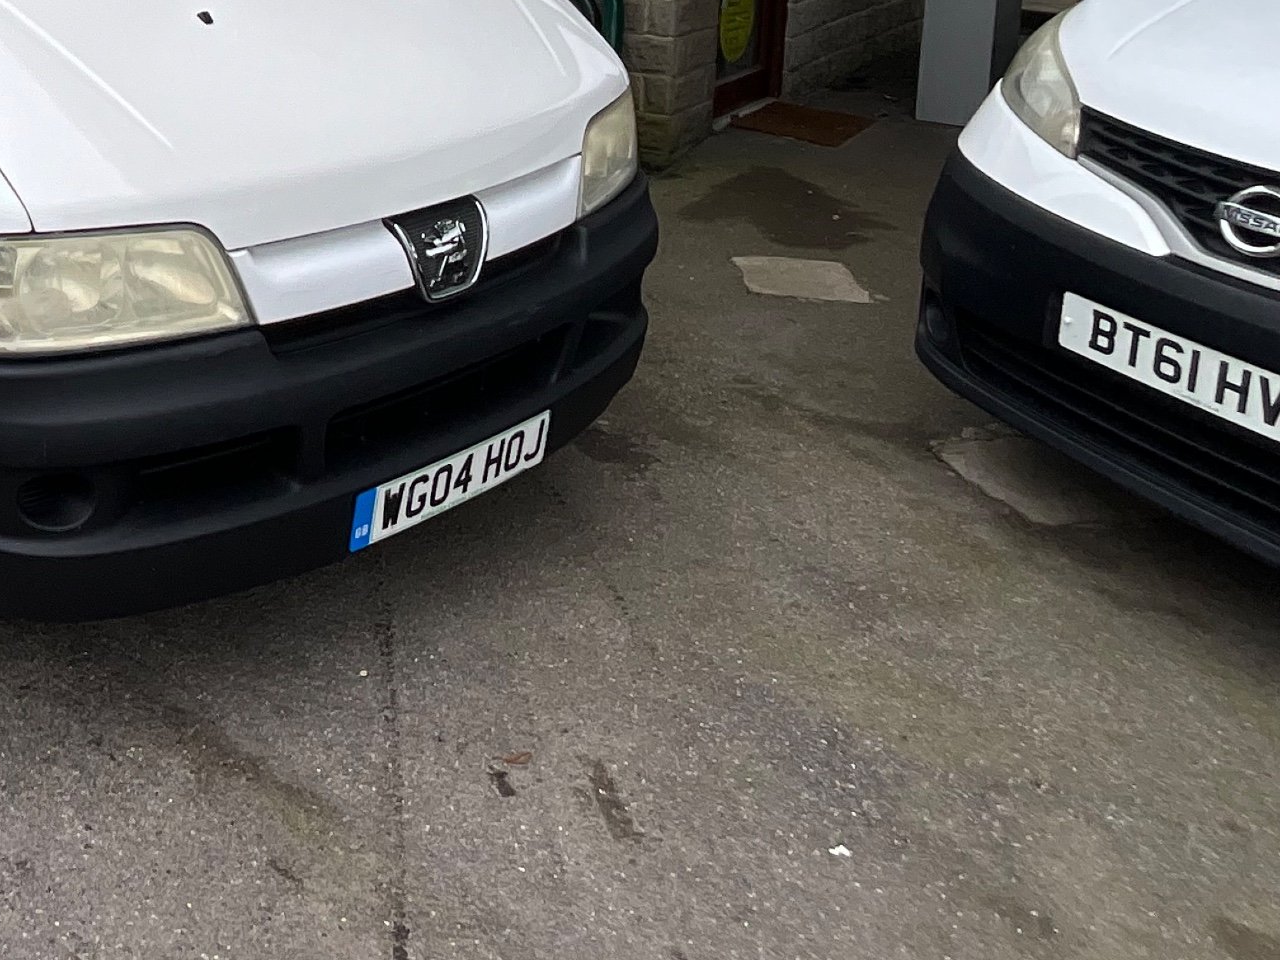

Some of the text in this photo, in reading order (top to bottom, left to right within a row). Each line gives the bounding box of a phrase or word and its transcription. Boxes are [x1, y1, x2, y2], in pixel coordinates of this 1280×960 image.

[1224, 206, 1280, 233] NISSA
[1088, 308, 1200, 394] BT61
[381, 452, 473, 531] WG04
